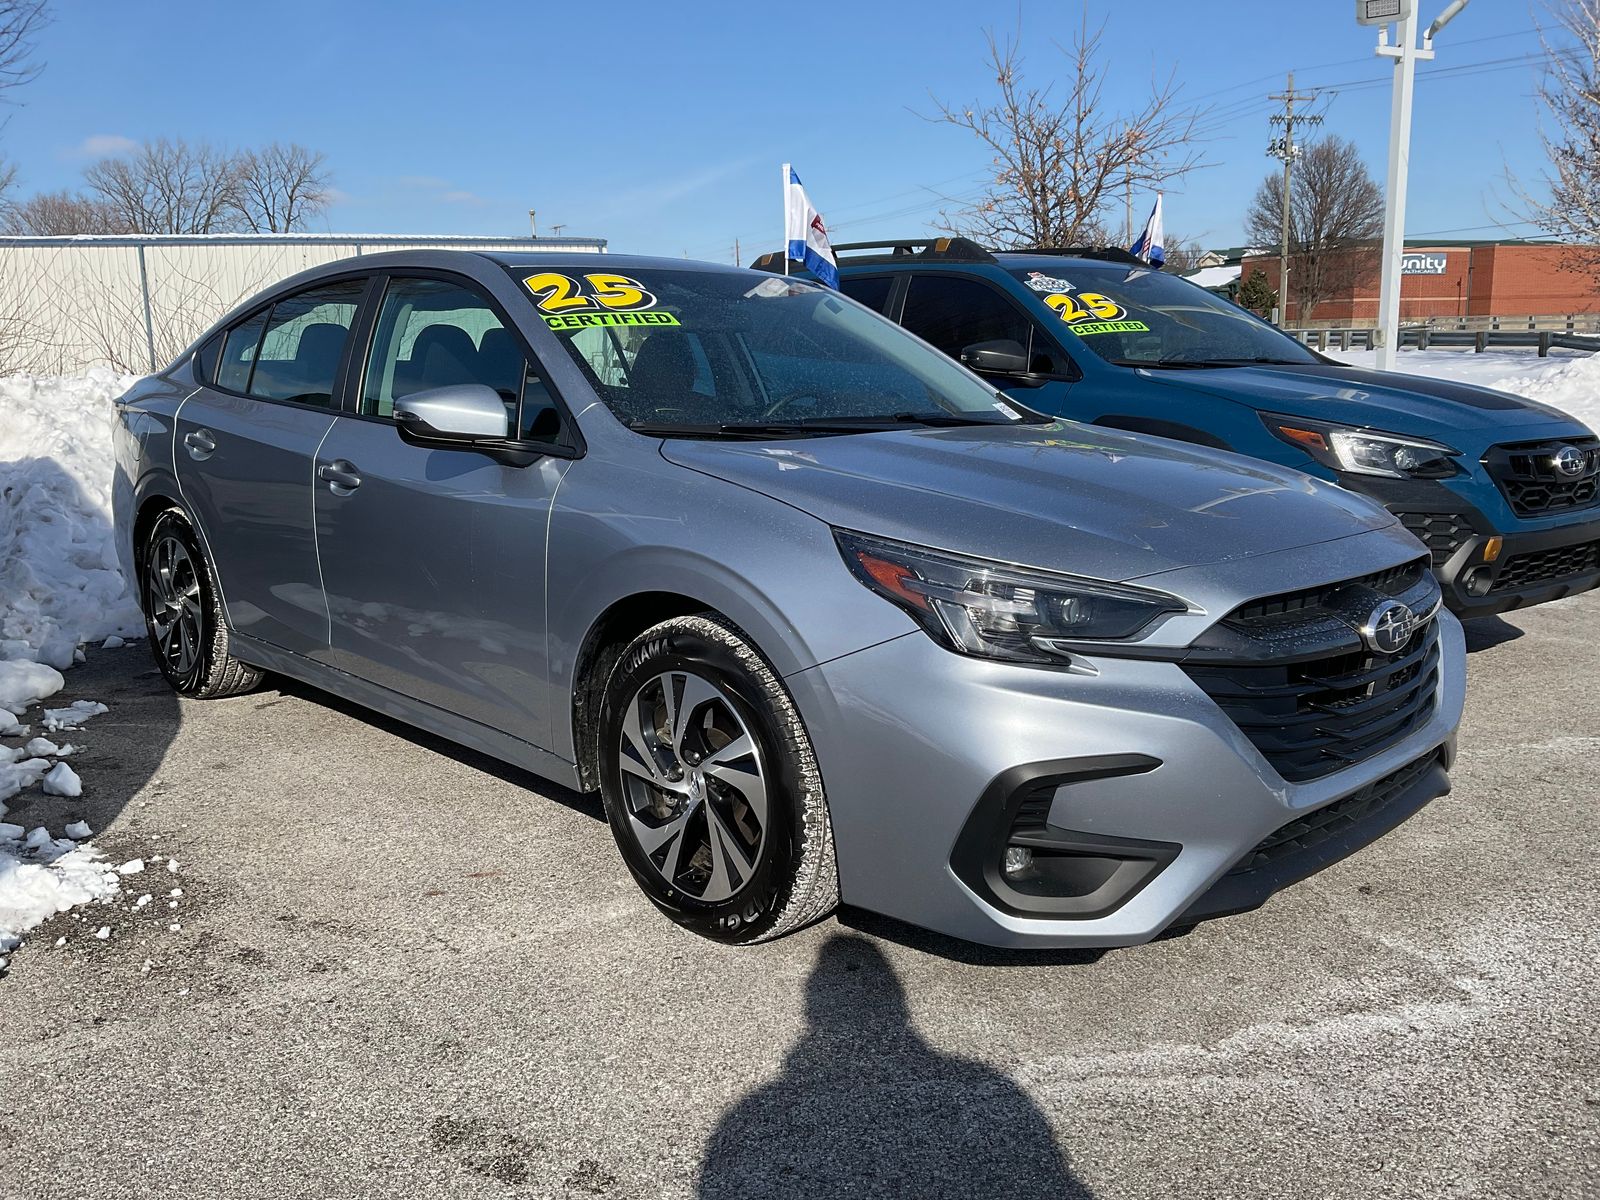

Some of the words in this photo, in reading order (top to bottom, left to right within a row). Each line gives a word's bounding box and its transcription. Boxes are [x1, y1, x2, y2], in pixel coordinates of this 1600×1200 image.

[522, 273, 658, 314] 25
[1043, 293, 1127, 324] 25
[545, 313, 673, 329] CERTIFIED
[1073, 321, 1144, 335] CERTIFIED
